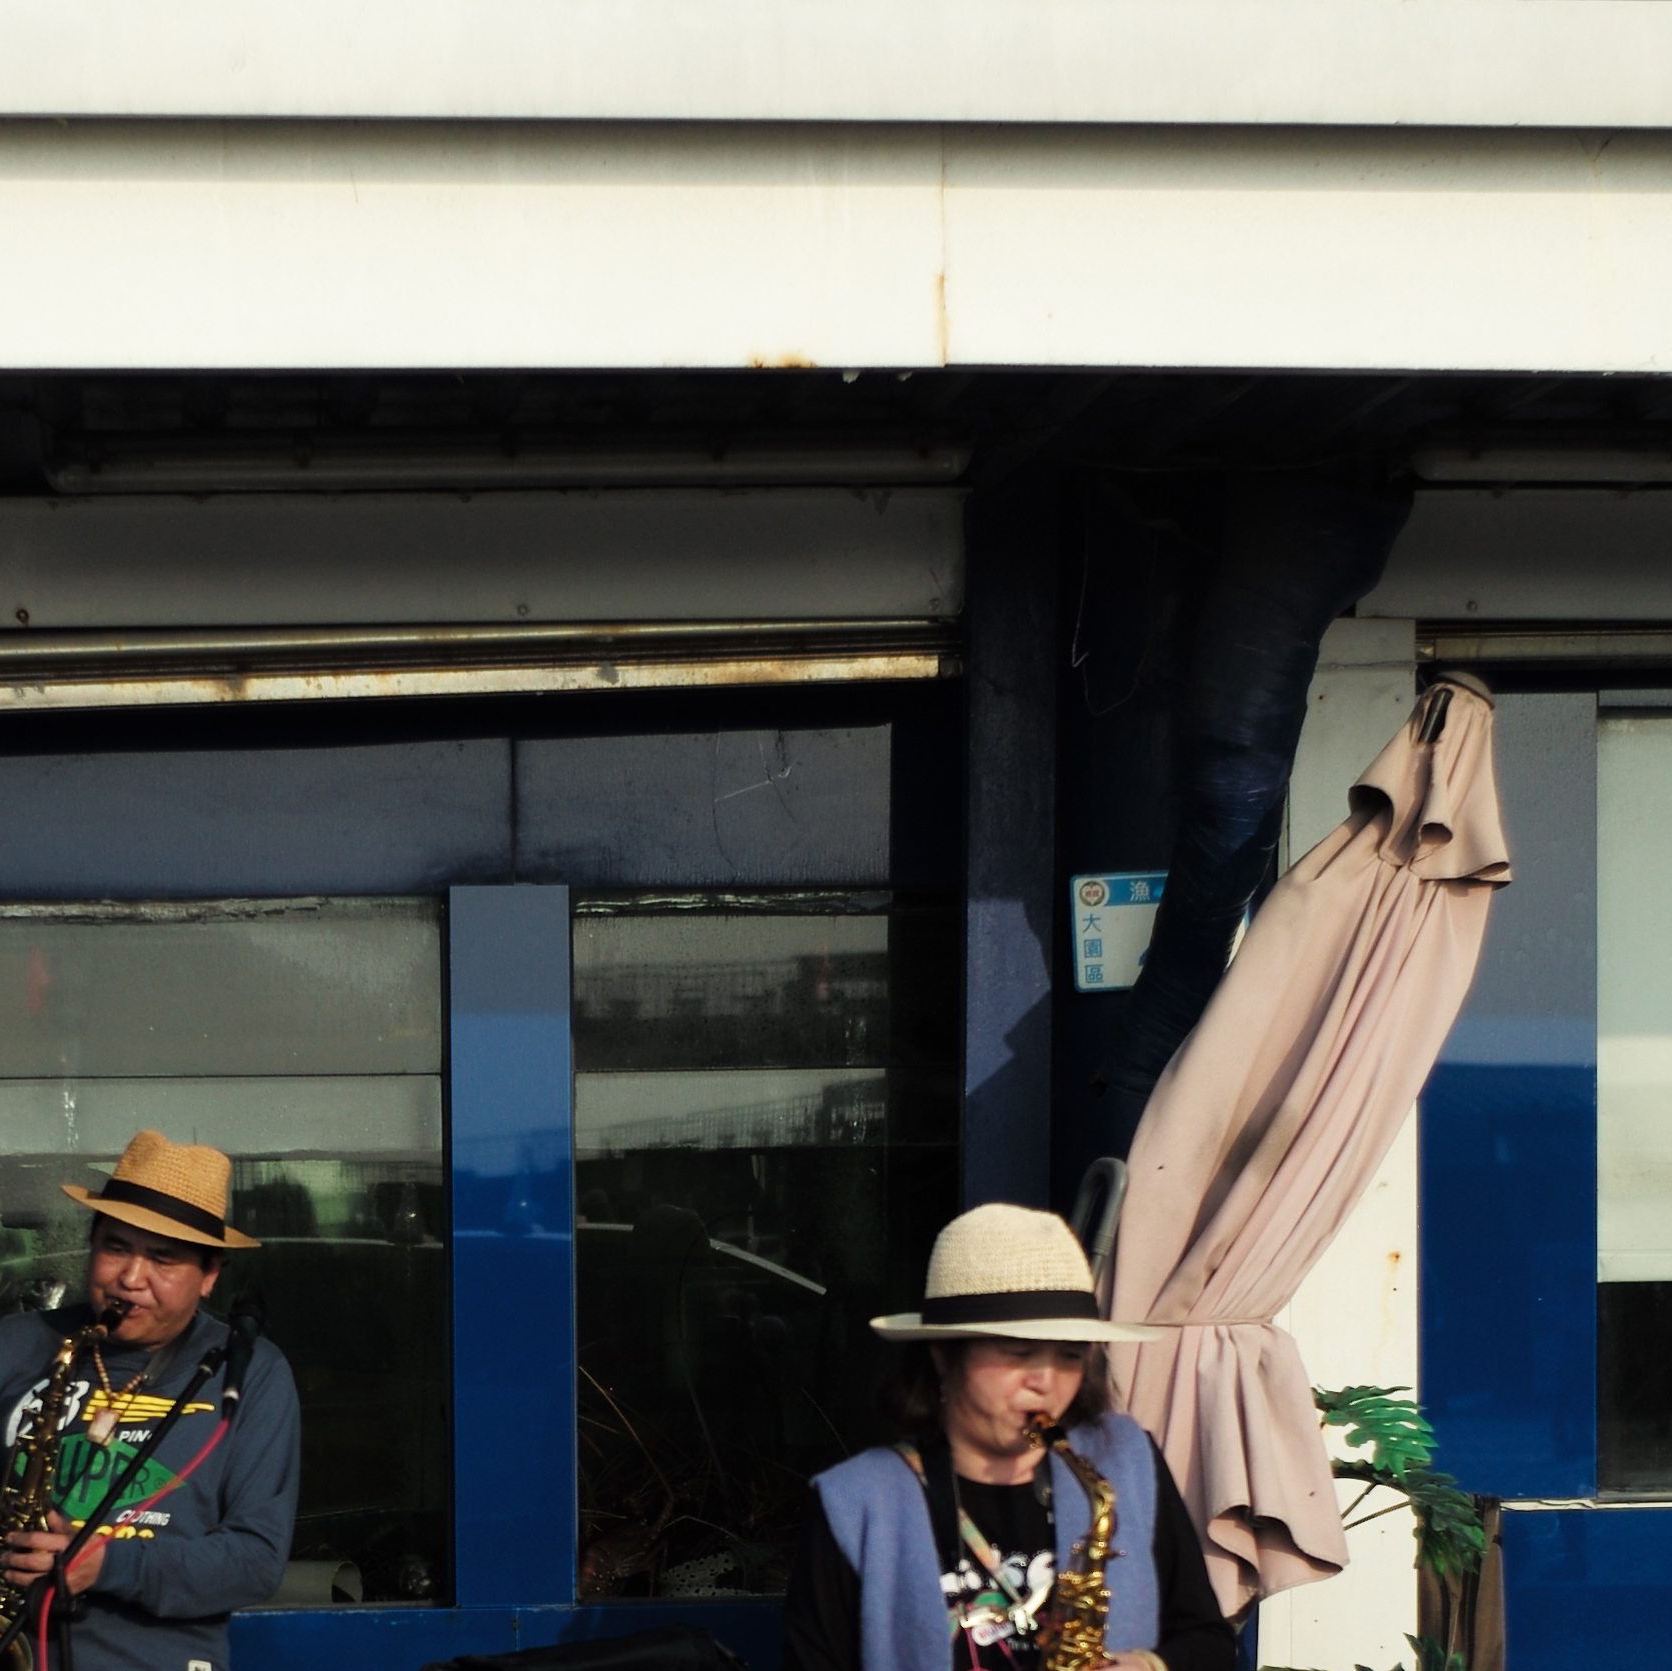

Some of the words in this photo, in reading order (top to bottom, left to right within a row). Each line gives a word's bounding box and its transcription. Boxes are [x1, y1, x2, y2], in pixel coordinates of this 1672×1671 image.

[1082, 913, 1104, 984] 大園區
[55, 1440, 150, 1503] UPER
